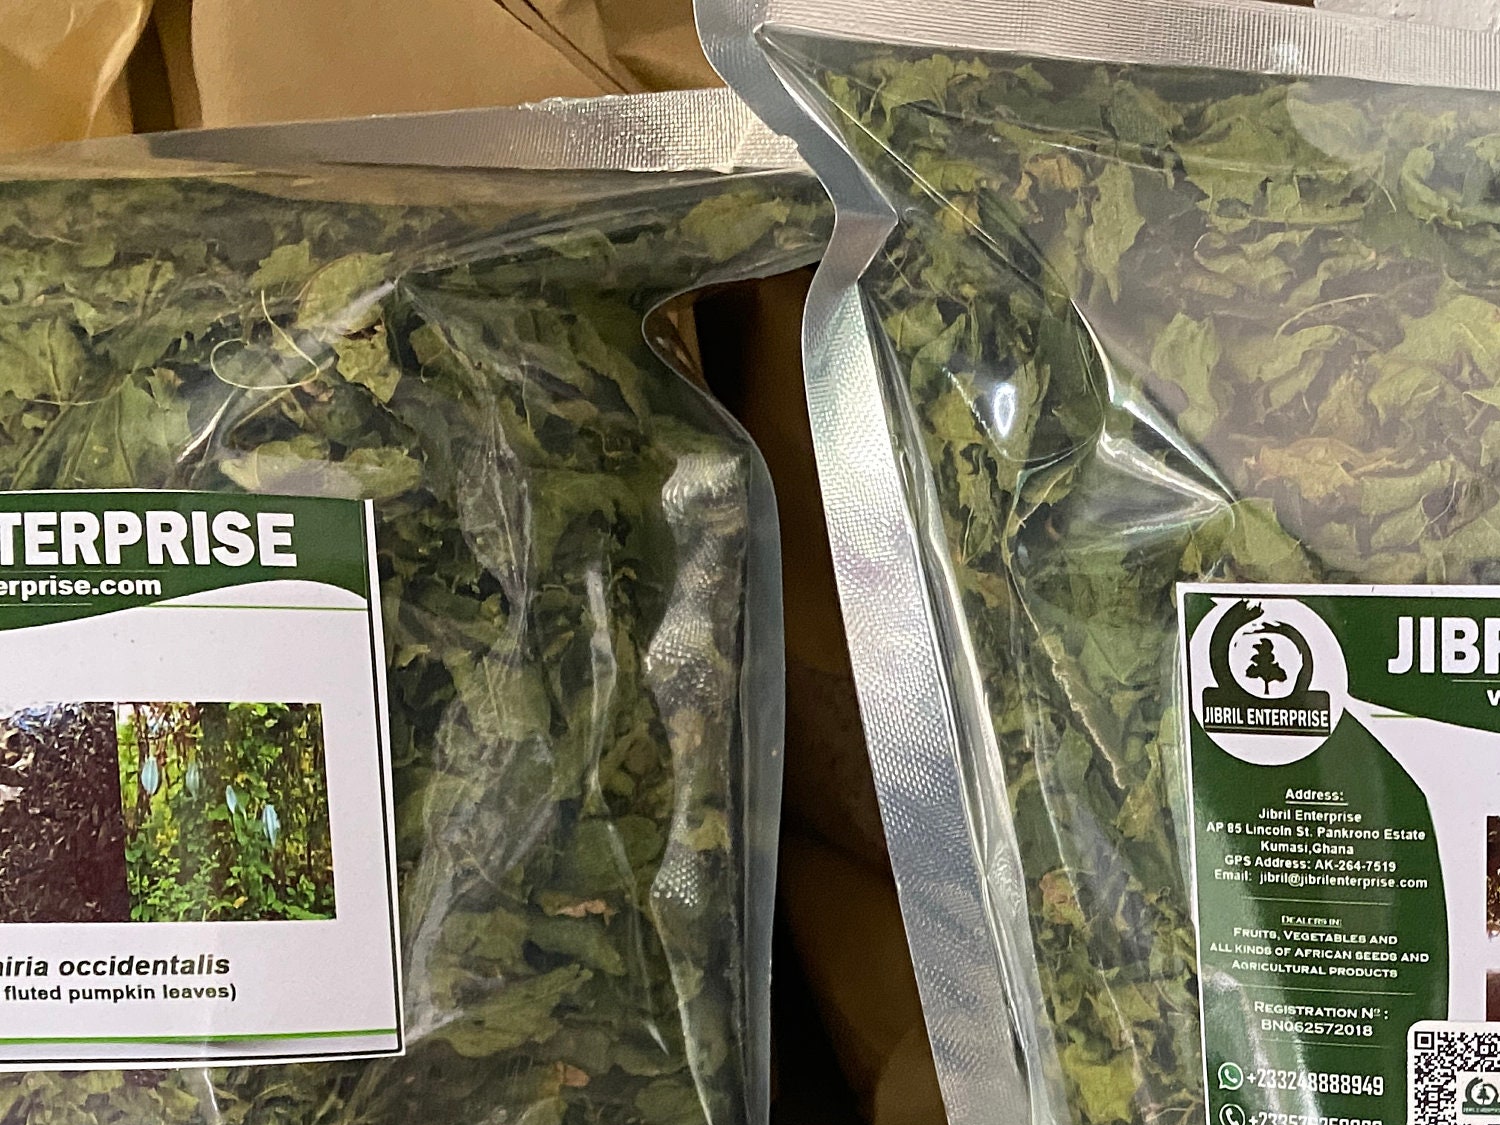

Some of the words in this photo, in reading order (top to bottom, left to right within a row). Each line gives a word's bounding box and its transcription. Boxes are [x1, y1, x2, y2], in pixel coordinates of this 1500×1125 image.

[0, 510, 298, 567] TERPRISE
[1204, 706, 1244, 724] JIBRIL
[1247, 708, 1329, 727] ENTERPRISE
[1285, 788, 1344, 801] Address:
[1258, 808, 1291, 820] Jibril
[1295, 809, 1362, 824] Enterprise
[1206, 822, 1224, 833] AP
[1227, 822, 1242, 834] 85
[1246, 823, 1292, 837] Lincoln
[1296, 825, 1313, 838] St.
[1317, 826, 1380, 840] Pankrono
[1383, 828, 1426, 841] Estate
[1224, 855, 1251, 866] GPS
[1255, 856, 1311, 870] Address:
[1314, 858, 1396, 872] AK-264-7519
[1214, 869, 1252, 881] Email:
[1259, 871, 1428, 889] jibril@jibrilenterprise.com
[1233, 927, 1281, 941] FRUITS,
[1284, 930, 1366, 944] VEGETABLES
[1369, 935, 1398, 945] AND
[1210, 942, 1232, 952] ALL
[1235, 944, 1272, 956] KINDS
[1274, 946, 1291, 957] OF
[1294, 948, 1352, 960] AFRICAN
[1355, 951, 1398, 962] SEEDS
[1400, 952, 1430, 963] AND
[0, 956, 49, 977] iria
[58, 954, 230, 976] occidentalis
[1231, 960, 1327, 976] AGRICULTURAL
[1329, 966, 1398, 979] PRODUCTS
[4, 985, 61, 1001] fluted
[68, 983, 156, 1003] pumpkin
[163, 983, 237, 1002] leaves)
[1254, 1001, 1358, 1019] REGISTRATION
[1261, 1019, 1373, 1036] BN062572018
[1246, 1068, 1384, 1096] +233248888949
